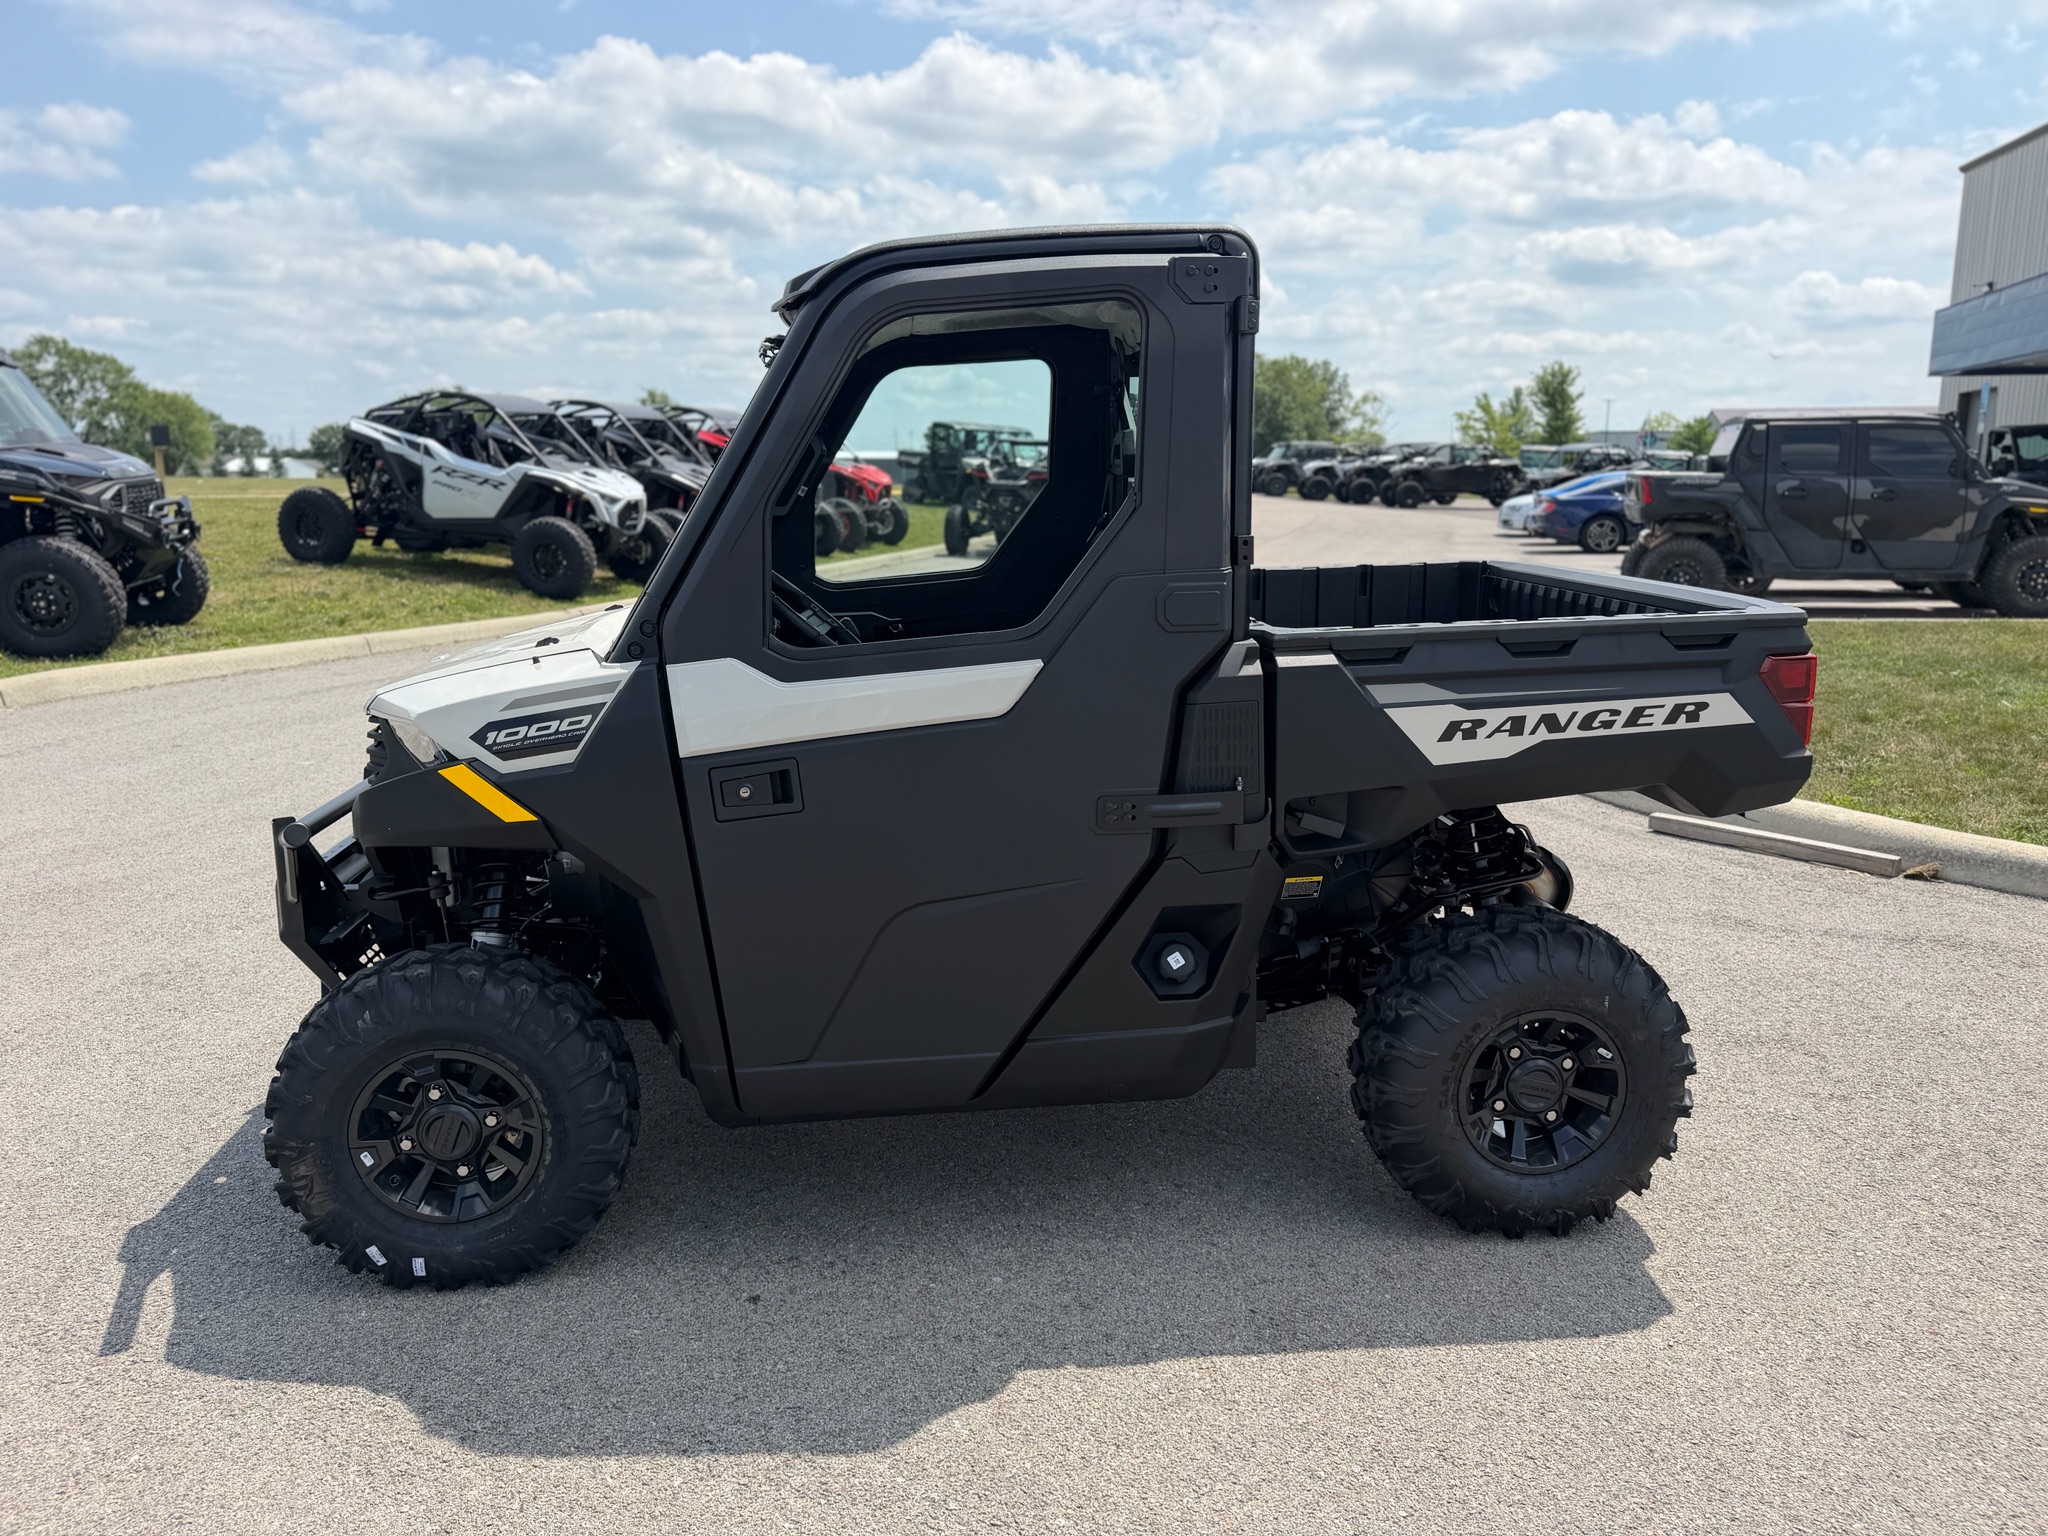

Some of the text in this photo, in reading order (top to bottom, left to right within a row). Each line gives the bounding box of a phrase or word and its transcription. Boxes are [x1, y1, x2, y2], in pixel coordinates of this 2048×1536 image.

[431, 465, 507, 491] RZR
[485, 714, 593, 746] 1000
[1437, 701, 1710, 743] RANGER
[492, 741, 522, 751] SINGLE
[524, 733, 566, 745] OVERHEAD
